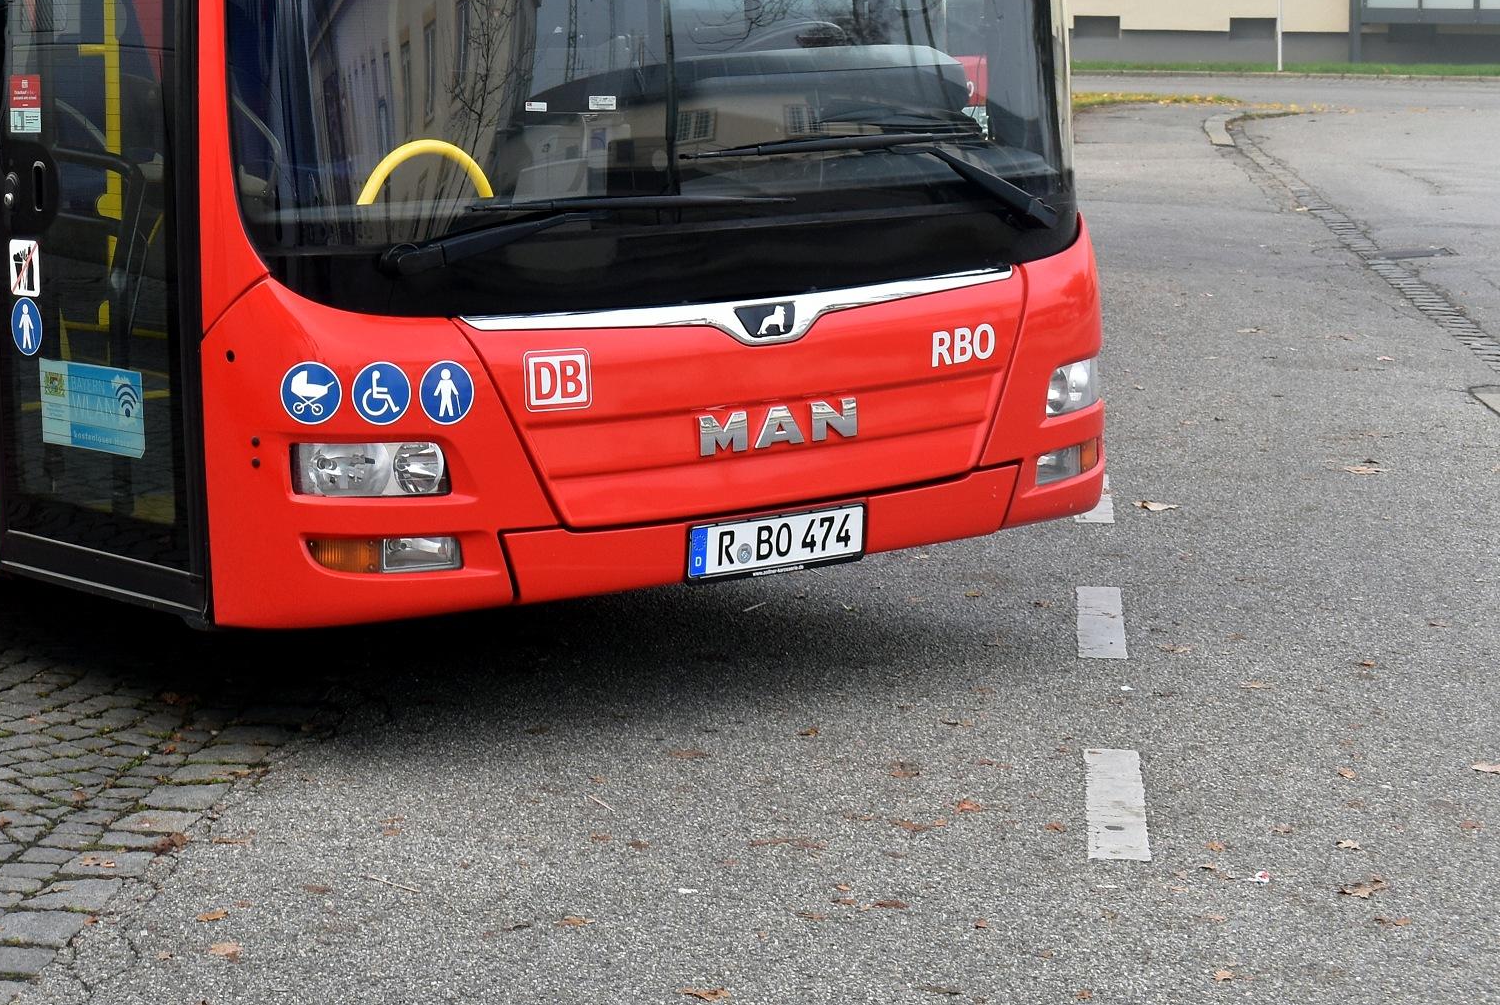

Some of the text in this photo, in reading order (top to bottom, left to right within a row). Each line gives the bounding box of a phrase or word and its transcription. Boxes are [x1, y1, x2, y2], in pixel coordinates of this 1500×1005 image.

[931, 323, 996, 367] RBO
[71, 375, 106, 394] BAYERN
[533, 359, 583, 400] DB
[71, 394, 118, 420] WLAN
[698, 397, 858, 457] MAN
[717, 513, 852, 567] R BO 474
[694, 556, 702, 568] D
